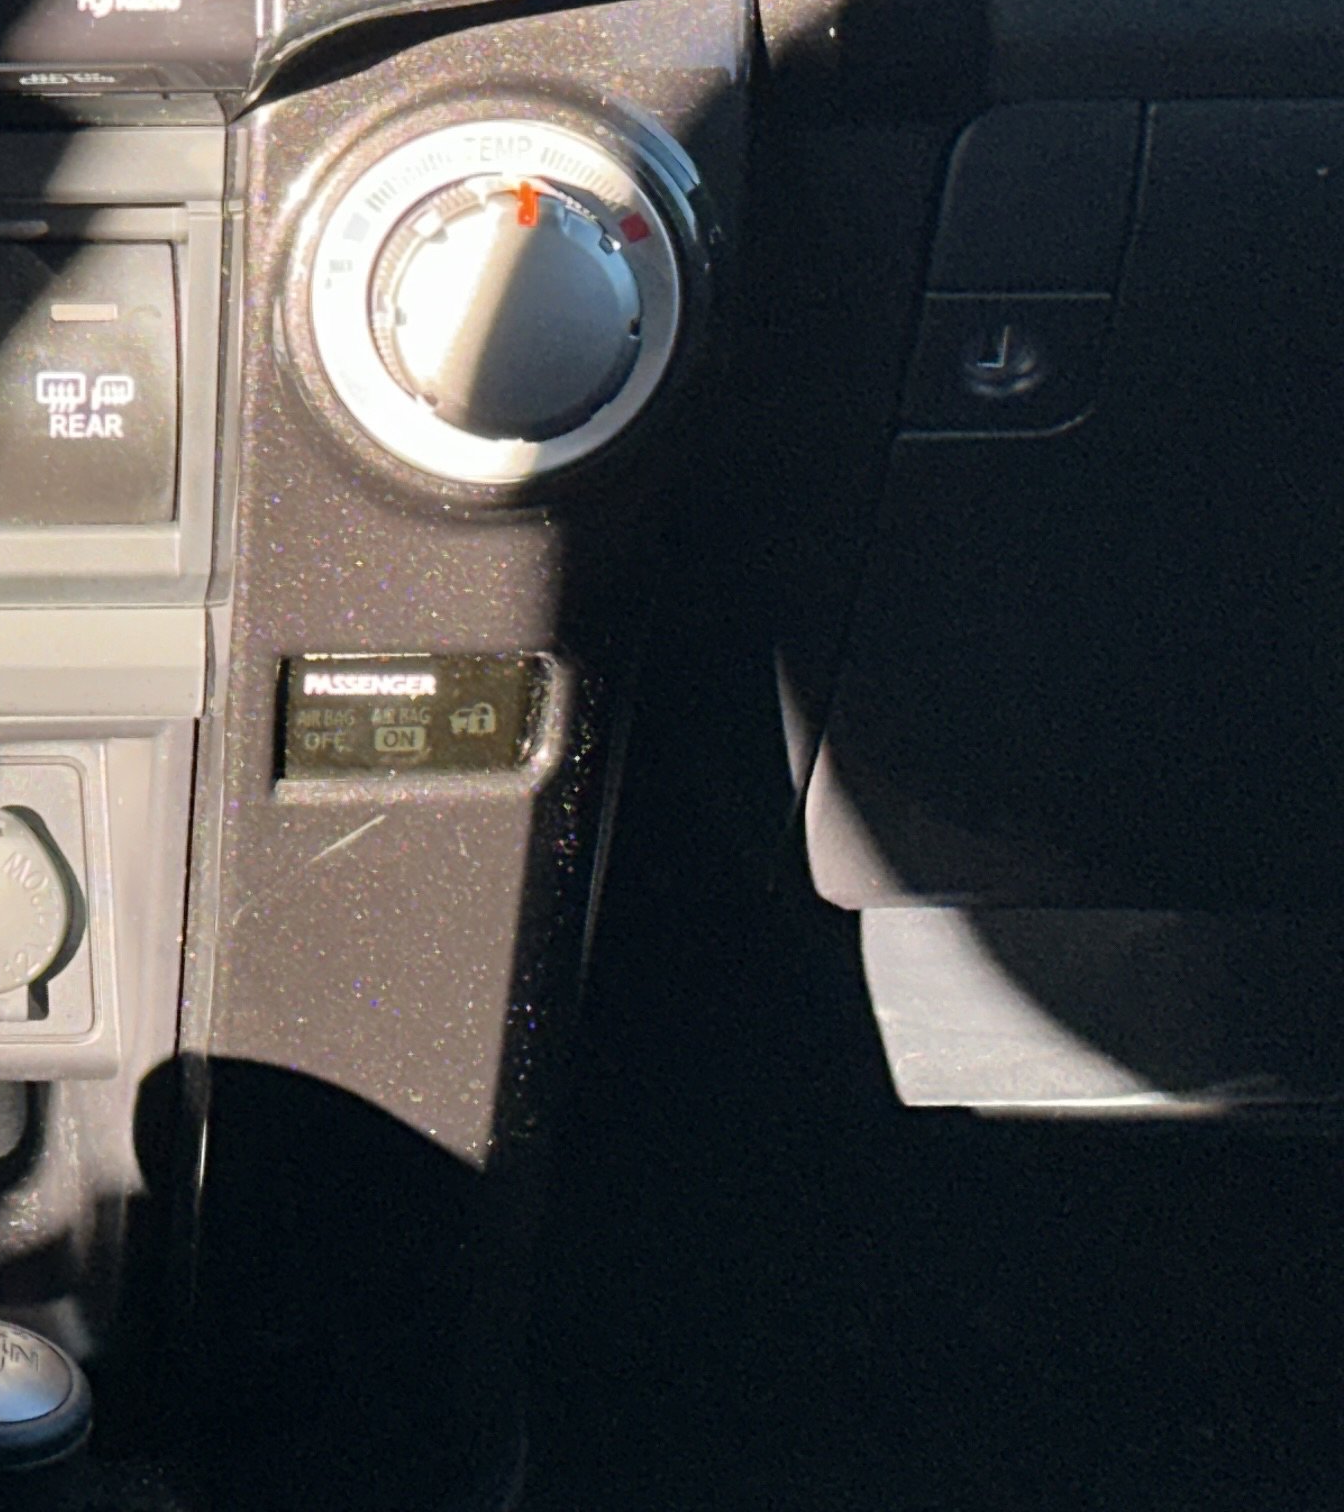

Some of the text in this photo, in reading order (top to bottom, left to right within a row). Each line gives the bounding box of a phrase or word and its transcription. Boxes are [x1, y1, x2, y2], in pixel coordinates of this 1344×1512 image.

[48, 413, 125, 439] REAR
[302, 672, 437, 696] PASSENGER
[382, 729, 415, 749] ON
